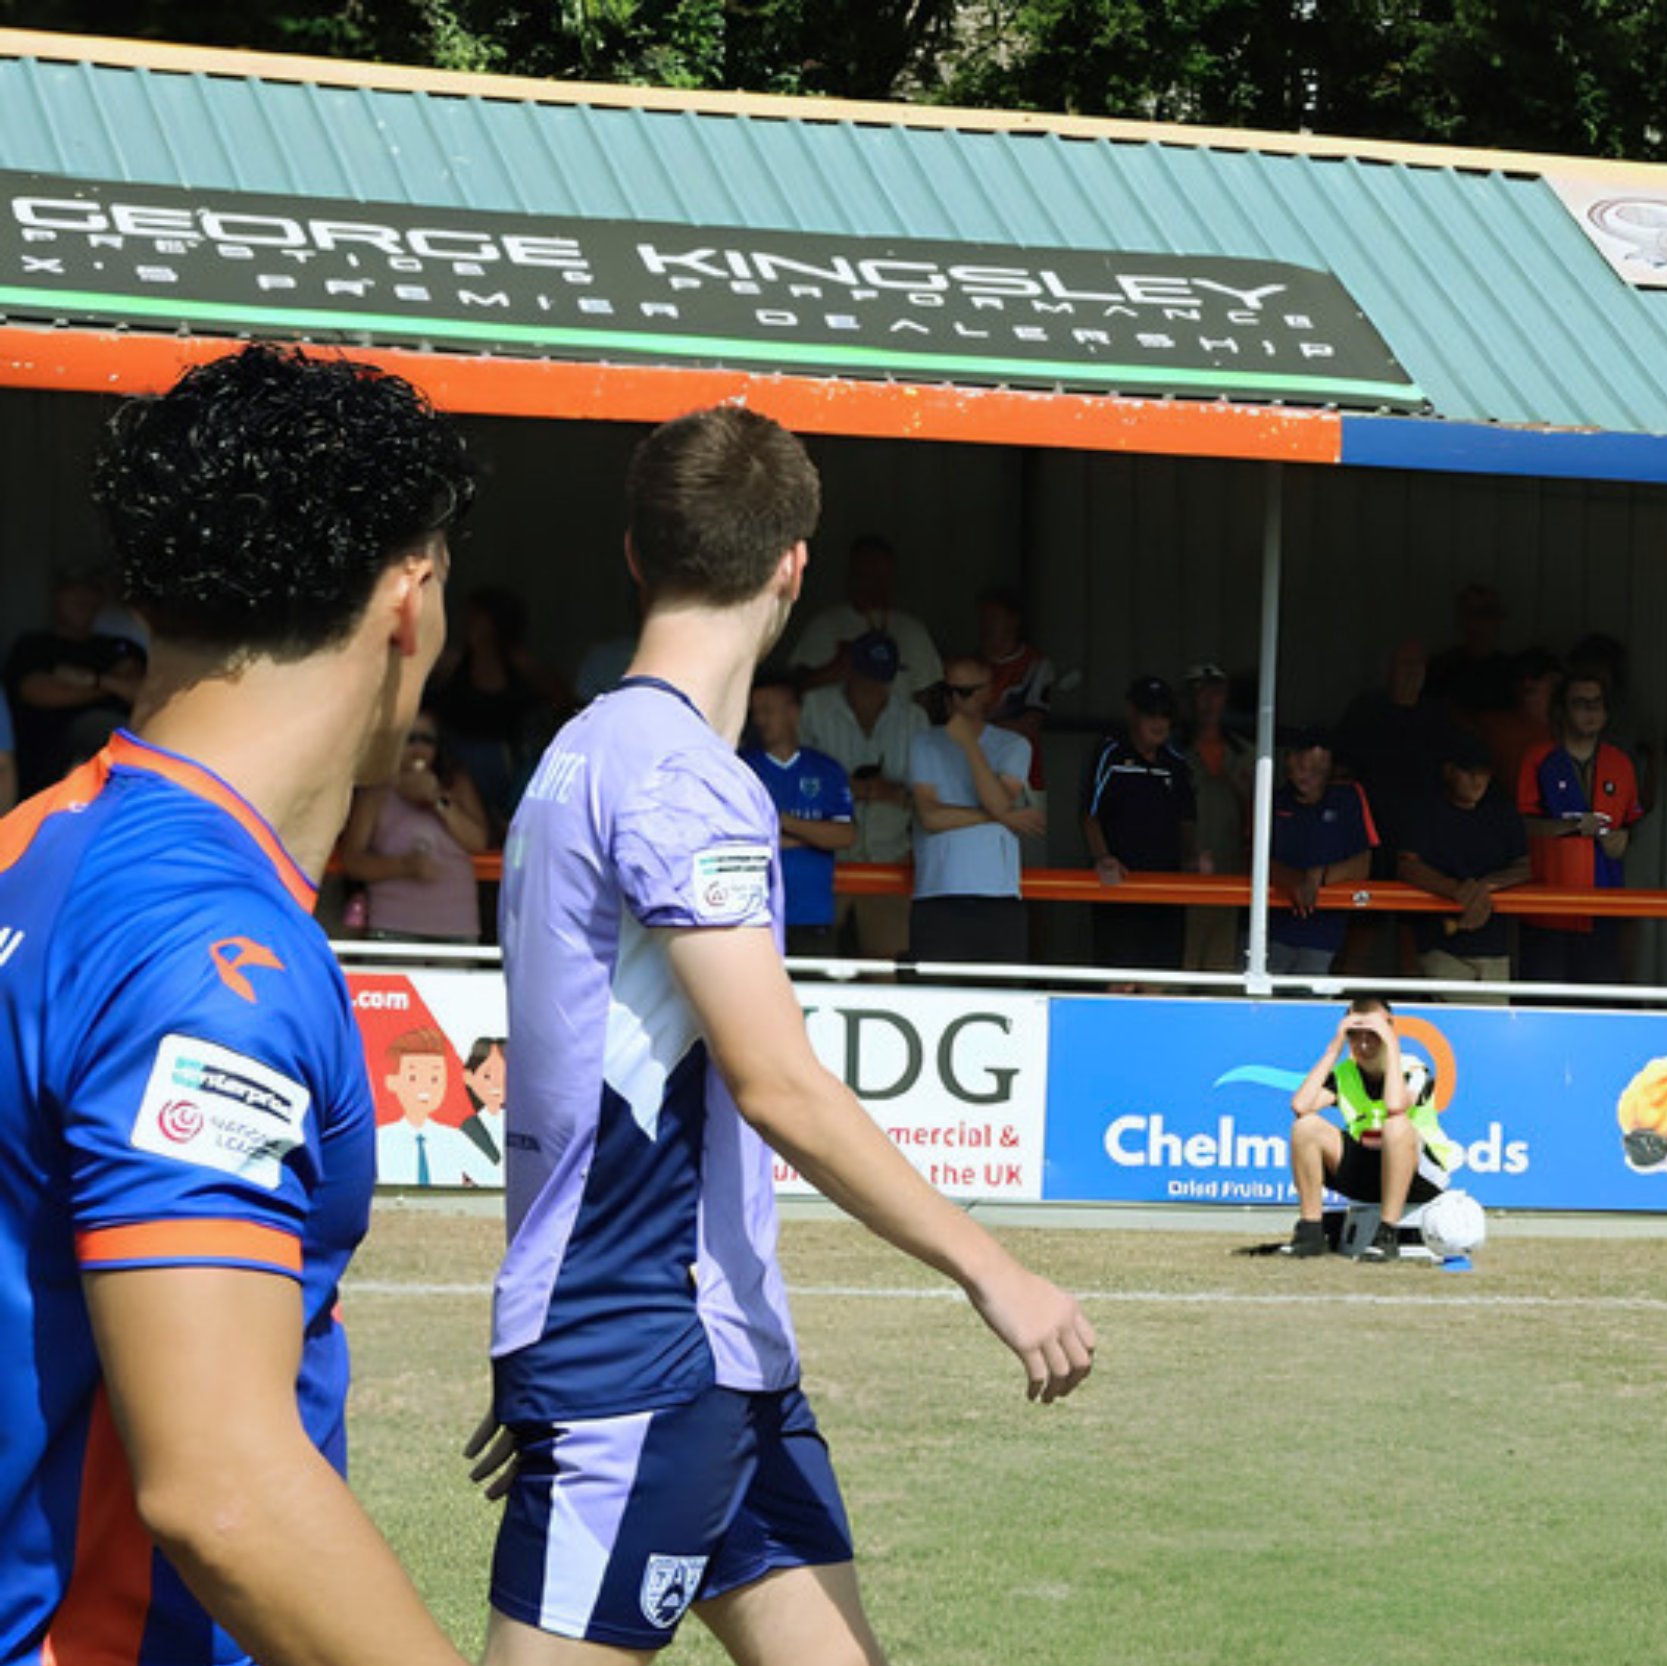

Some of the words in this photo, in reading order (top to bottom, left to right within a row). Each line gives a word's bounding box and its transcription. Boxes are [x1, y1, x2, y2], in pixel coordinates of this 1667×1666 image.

[12, 197, 590, 269] GEORGE
[636, 242, 1287, 310] KINGSLEY
[257, 273, 680, 319] PREMIER
[756, 309, 1336, 359] DEALERSHIP
[669, 276, 1315, 329] PERFORMANCE
[803, 1006, 1021, 1106] DG
[888, 1121, 991, 1148] mercial
[1000, 1125, 1020, 1148] &
[1104, 1114, 1289, 1169] Chelm
[930, 1162, 976, 1185] the
[984, 1165, 1022, 1186] UK
